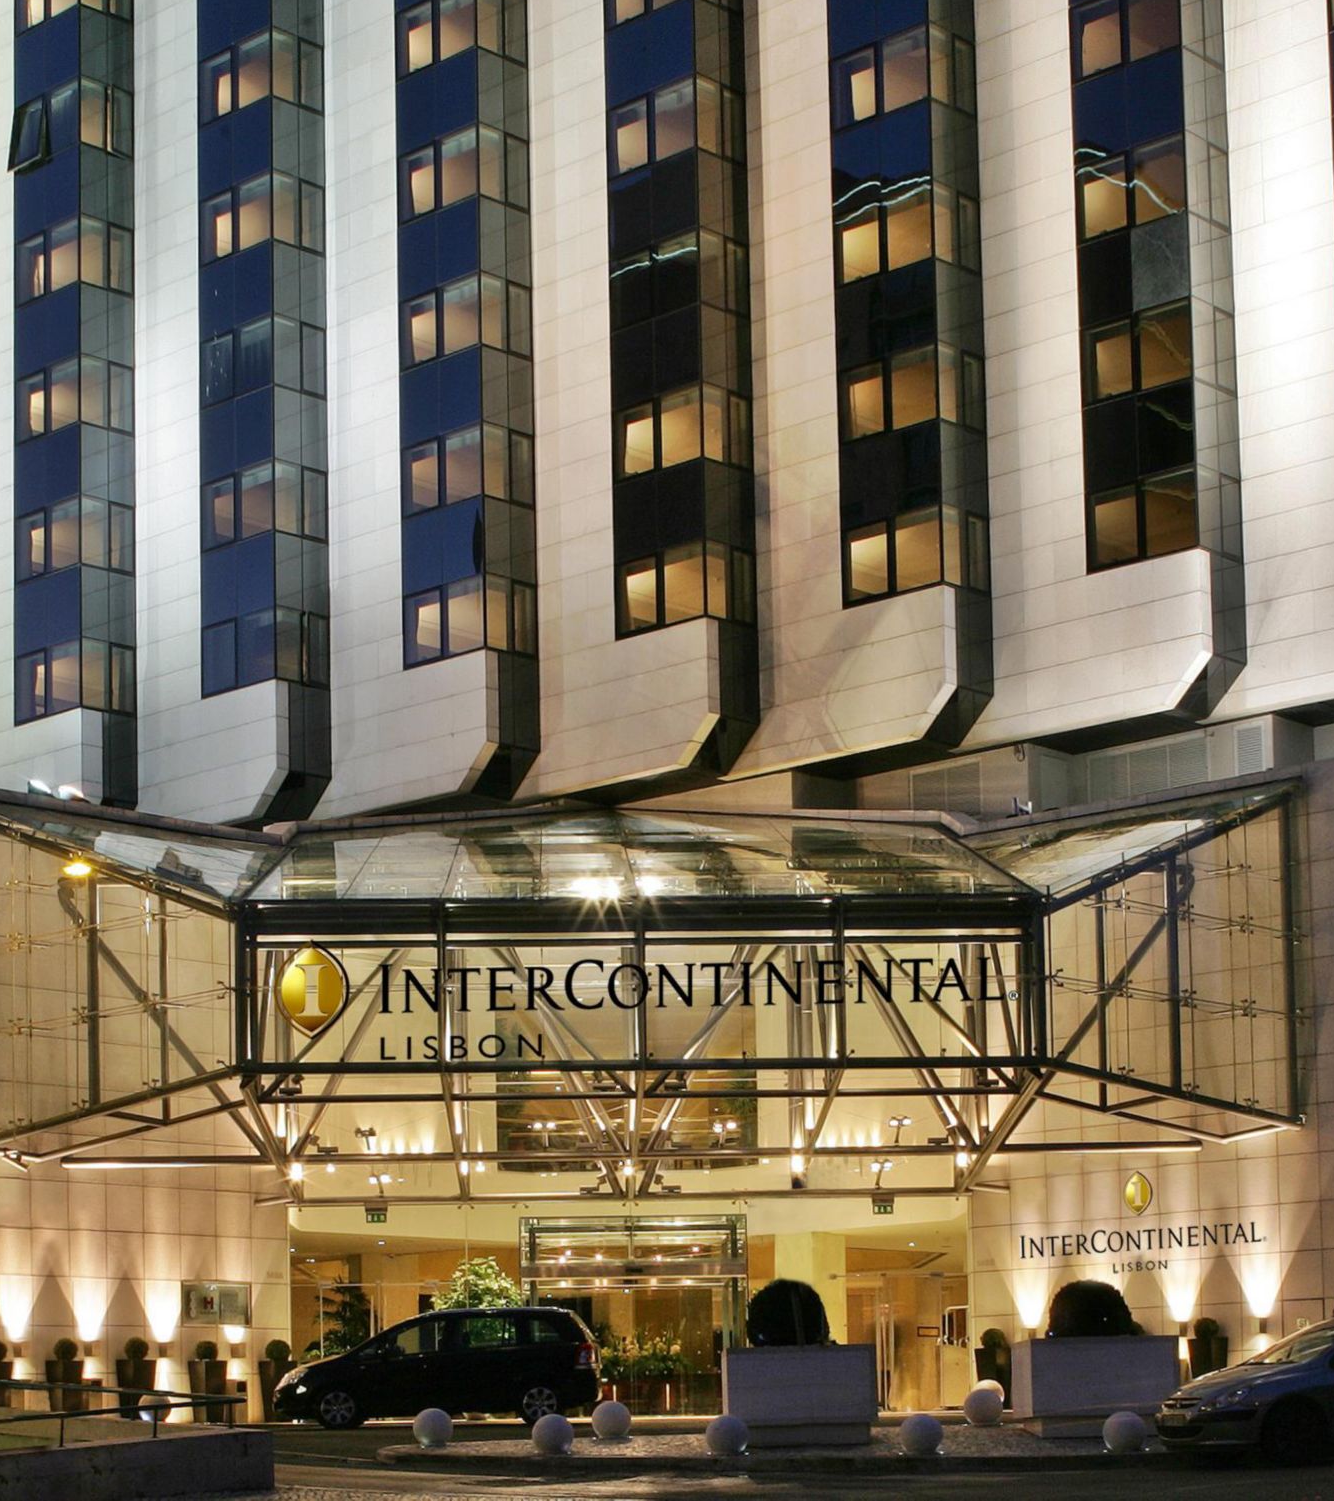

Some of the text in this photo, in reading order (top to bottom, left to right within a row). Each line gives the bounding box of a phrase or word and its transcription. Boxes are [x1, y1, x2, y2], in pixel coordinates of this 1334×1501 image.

[378, 957, 1005, 1014] INTERCONTINENTAL
[380, 1033, 543, 1060] LISBON
[1019, 1221, 1263, 1260] INTERCONTINENTAL
[1112, 1260, 1169, 1274] LISBON
